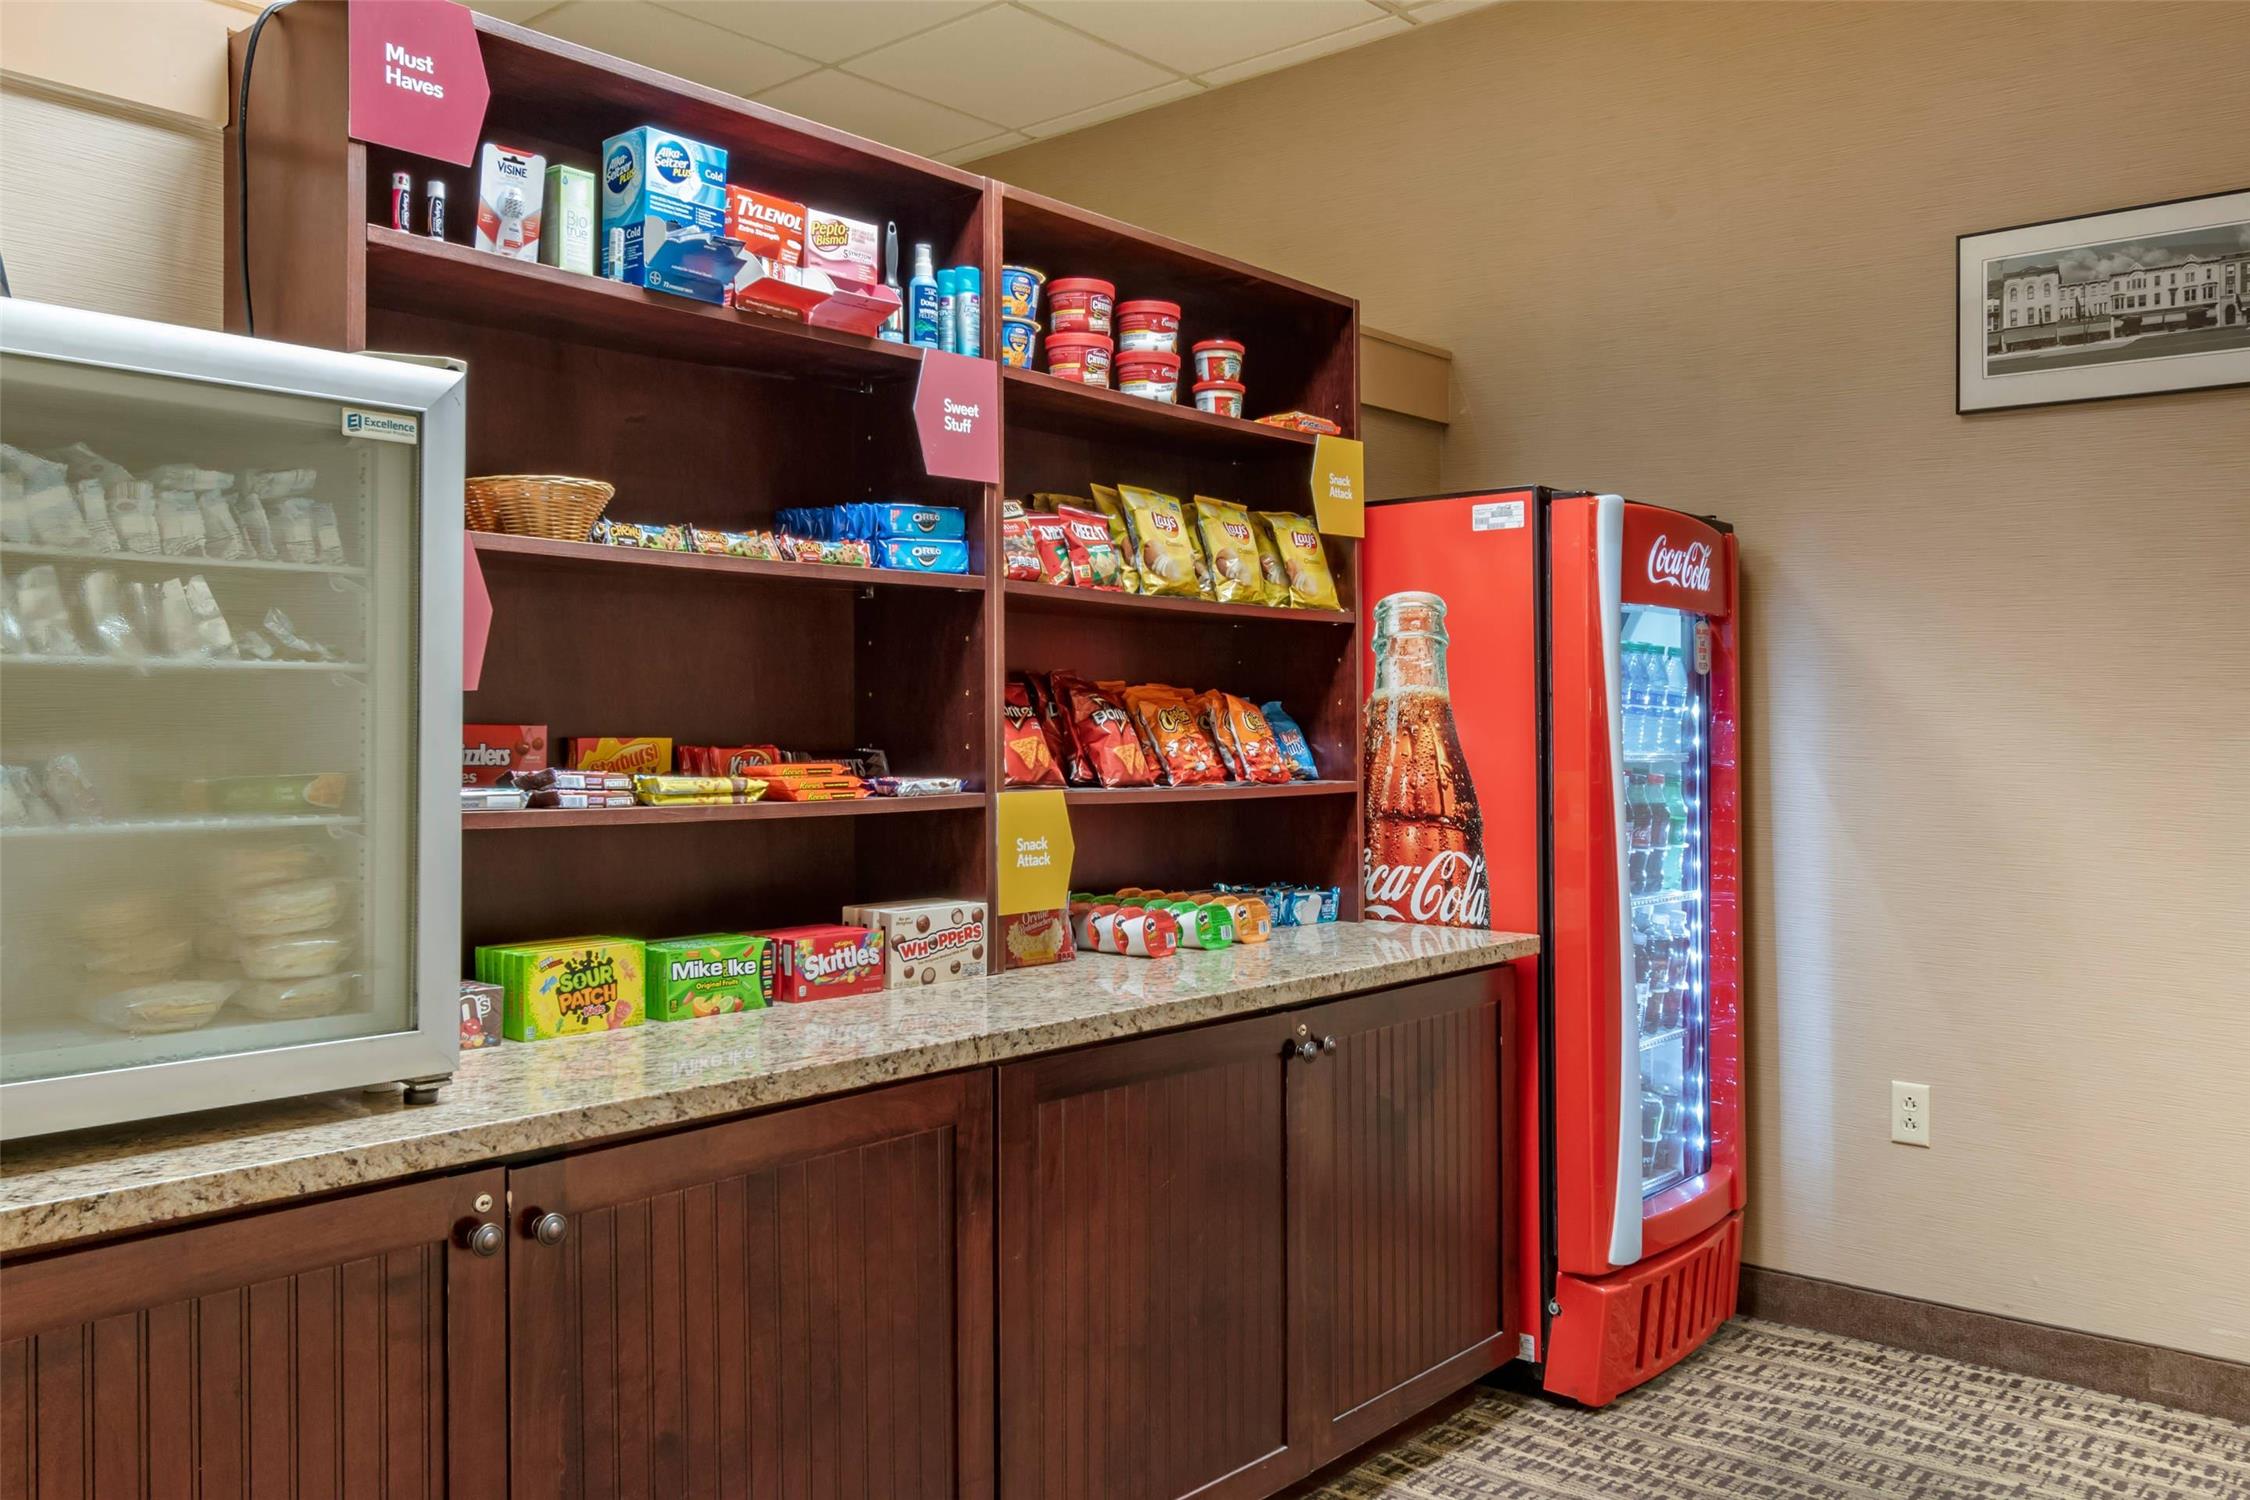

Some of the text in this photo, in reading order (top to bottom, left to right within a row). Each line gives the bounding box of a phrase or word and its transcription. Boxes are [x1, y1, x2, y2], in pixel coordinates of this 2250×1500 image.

[385, 42, 434, 74] Must
[385, 64, 444, 99] Haves
[655, 156, 689, 169] Seltzer
[607, 161, 632, 184] Seltzer
[619, 169, 635, 185] PLUS
[672, 168, 692, 178] PLUS
[705, 169, 724, 183] Cold
[567, 210, 588, 229] Bio
[737, 194, 803, 232] TYLENOL
[626, 226, 641, 240] Cold
[815, 232, 849, 247] Bismol
[944, 398, 979, 418] Sweet
[364, 416, 416, 433] Excellence
[944, 416, 972, 433] Stuff
[1329, 473, 1352, 487] Snack
[1329, 486, 1353, 500] Attack
[912, 511, 941, 522] OREO
[1154, 513, 1178, 532] Lay's
[1225, 523, 1248, 538] Lay's
[1294, 532, 1316, 549] Lay's
[911, 547, 942, 556] OREO
[1648, 534, 1712, 592] Coca-Cola
[1016, 836, 1048, 852] Snack
[1016, 852, 1051, 868] Attack
[899, 923, 982, 959] WHOPPERS
[672, 960, 723, 981] Mike
[727, 958, 757, 977] Ike
[803, 945, 881, 982] Skittles
[559, 964, 614, 993] SOUR
[696, 980, 721, 990] Original
[558, 981, 618, 1016] PATCH
[583, 1004, 607, 1018] Kids
